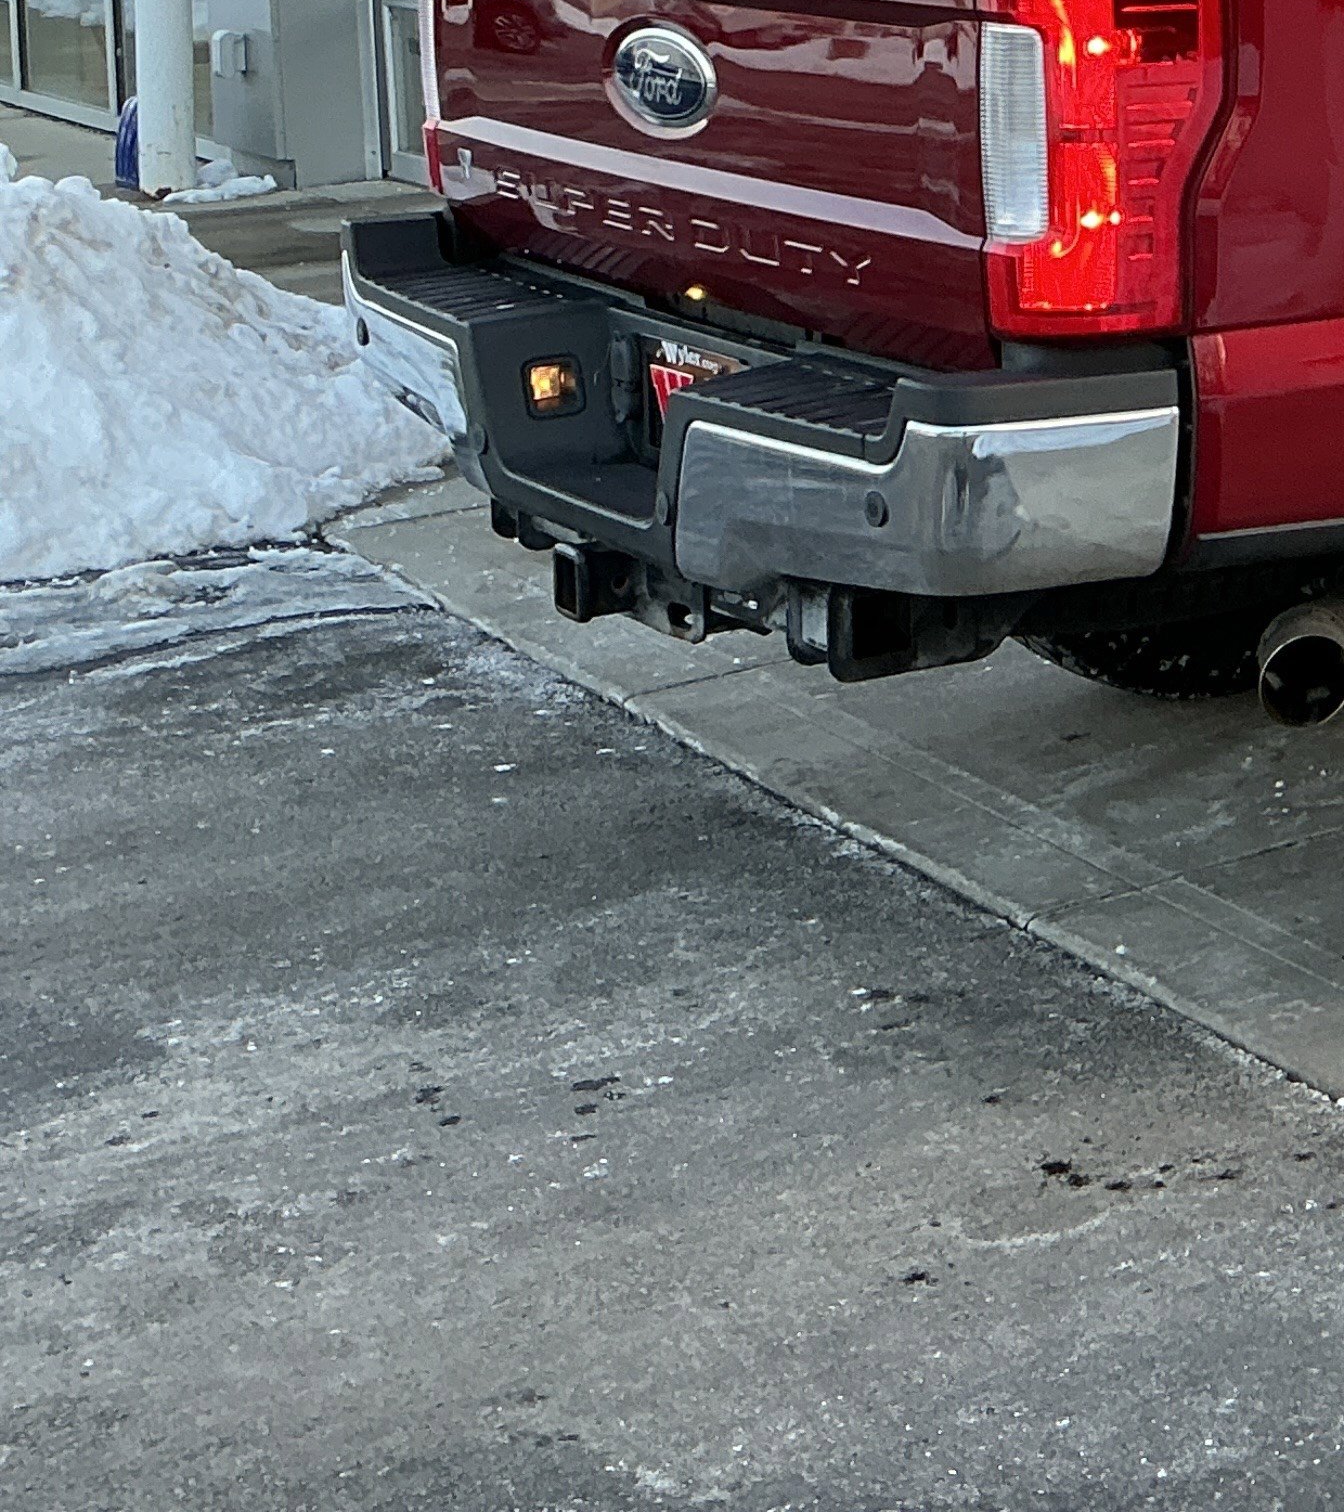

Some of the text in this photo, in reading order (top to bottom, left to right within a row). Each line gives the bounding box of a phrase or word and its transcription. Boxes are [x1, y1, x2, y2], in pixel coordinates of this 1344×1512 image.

[629, 47, 684, 106] Ford
[494, 165, 872, 286] SUPER DUTY
